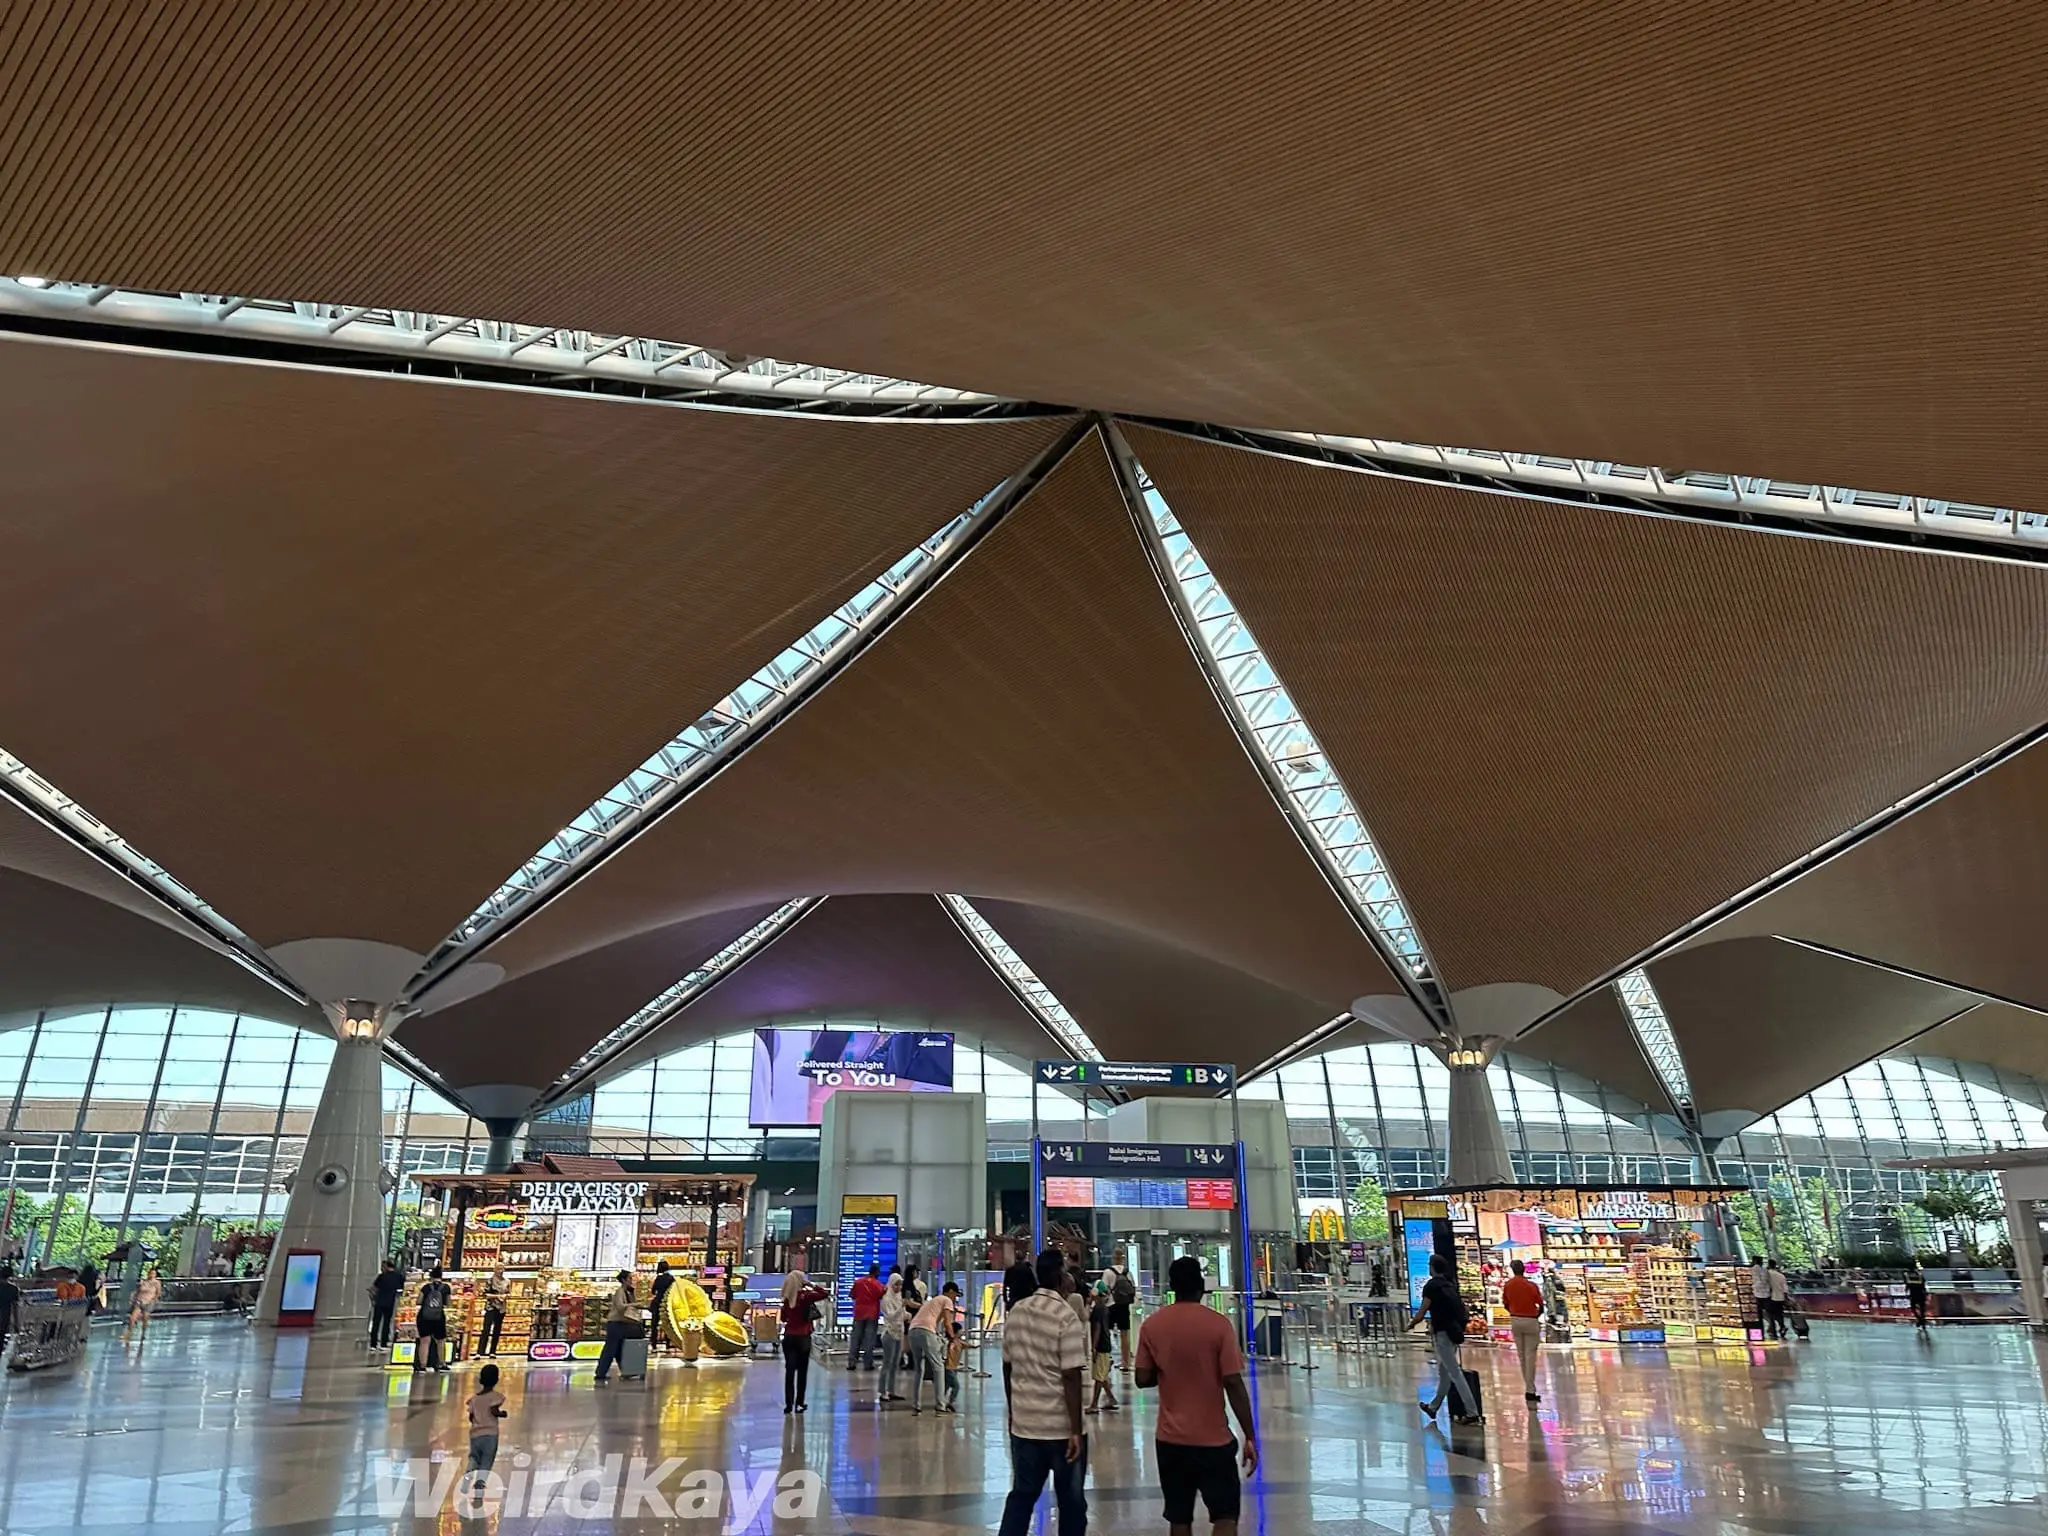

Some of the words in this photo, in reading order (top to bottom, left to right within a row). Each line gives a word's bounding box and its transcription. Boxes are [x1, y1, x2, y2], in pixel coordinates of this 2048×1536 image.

[797, 1061, 843, 1069] Delivered
[845, 1061, 884, 1070] Straight
[812, 1069, 842, 1086] To
[849, 1070, 896, 1087] You
[1195, 1068, 1208, 1083] B
[520, 1182, 622, 1196] DELICACIES
[624, 1182, 649, 1196] OF
[528, 1196, 639, 1214] MALAYSIA
[1602, 1191, 1650, 1204] LITTLE
[1588, 1204, 1669, 1219] MALAYSIA
